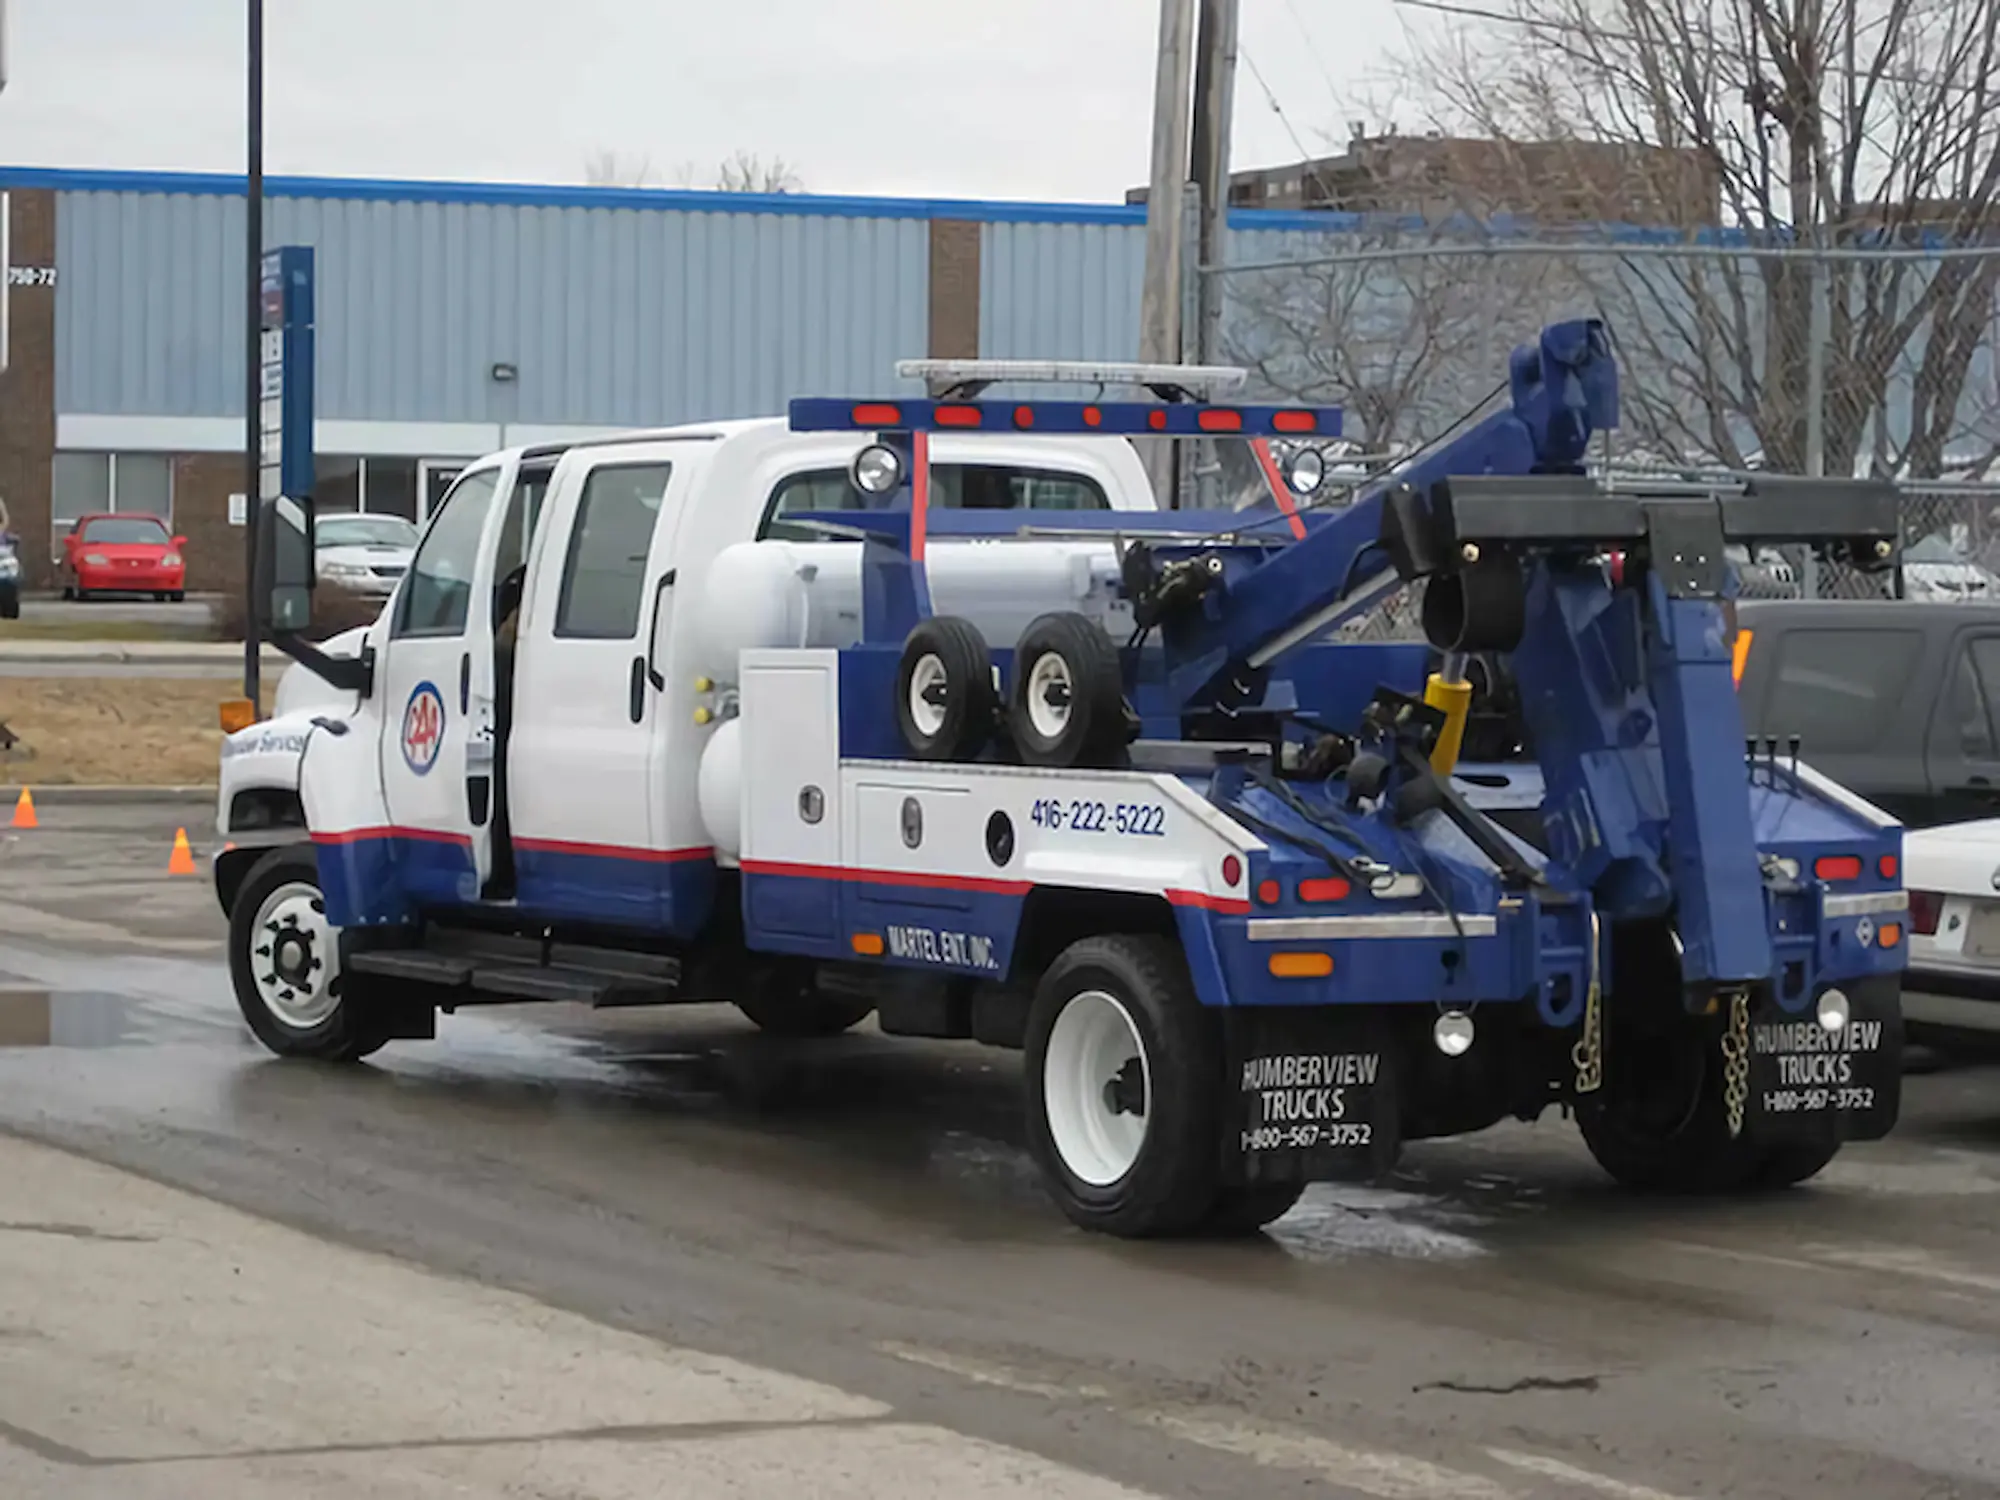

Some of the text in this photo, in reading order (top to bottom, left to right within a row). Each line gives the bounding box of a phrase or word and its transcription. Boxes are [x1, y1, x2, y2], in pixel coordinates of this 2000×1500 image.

[1031, 799, 1165, 836] 416-222-5222
[887, 925, 941, 961] MARTEL
[1241, 1054, 1380, 1091] HUMBERVIEW
[1778, 1054, 1852, 1085] TRUCKS
[1261, 1088, 1345, 1121] TRUCKS
[1241, 1123, 1372, 1151] 1-800-567-3752
